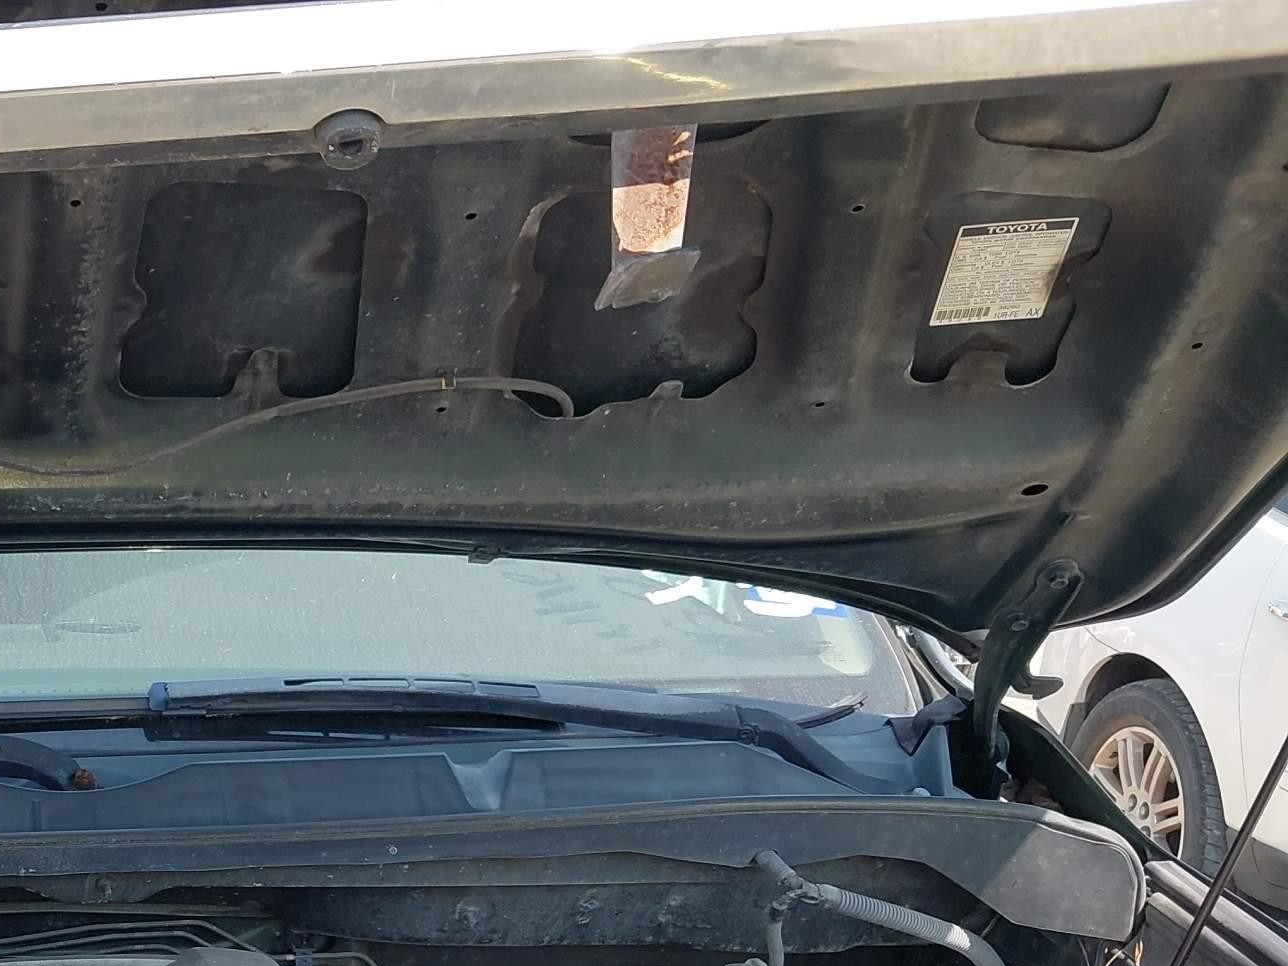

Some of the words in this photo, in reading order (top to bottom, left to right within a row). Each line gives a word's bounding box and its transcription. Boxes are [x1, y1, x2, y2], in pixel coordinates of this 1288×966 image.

[987, 223, 1048, 234] TOYOTA
[994, 310, 1019, 319] 1UR-FE
[1025, 306, 1041, 318] AX
